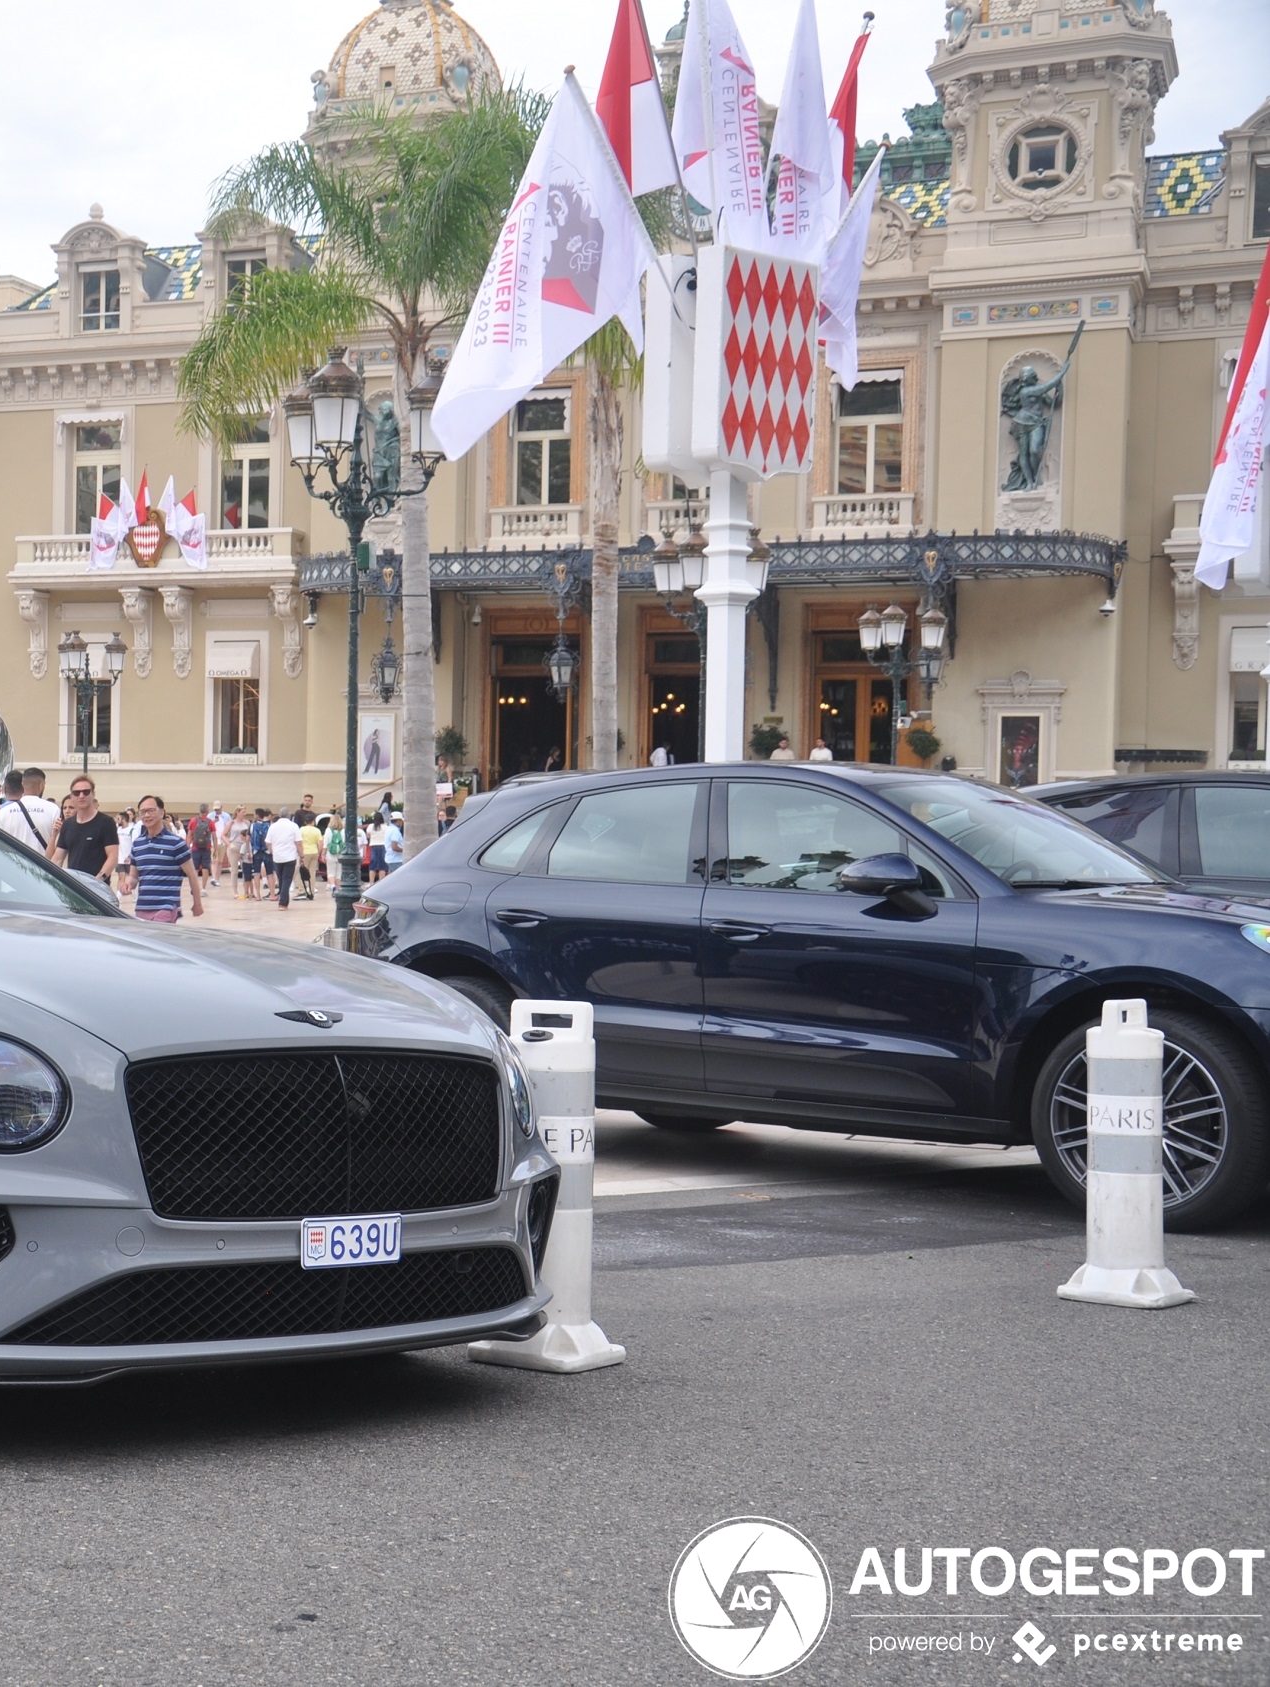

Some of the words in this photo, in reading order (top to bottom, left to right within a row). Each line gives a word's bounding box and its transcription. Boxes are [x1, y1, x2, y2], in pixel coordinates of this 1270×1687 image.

[781, 212, 795, 235] III
[494, 222, 518, 313] RAINIER
[514, 201, 538, 348] CENTENAIRE
[492, 323, 510, 344] III
[216, 669, 240, 677] OMEGA
[1090, 1104, 1156, 1130] PARIS
[310, 1245, 323, 1255] MC
[330, 1222, 398, 1260] 639U
